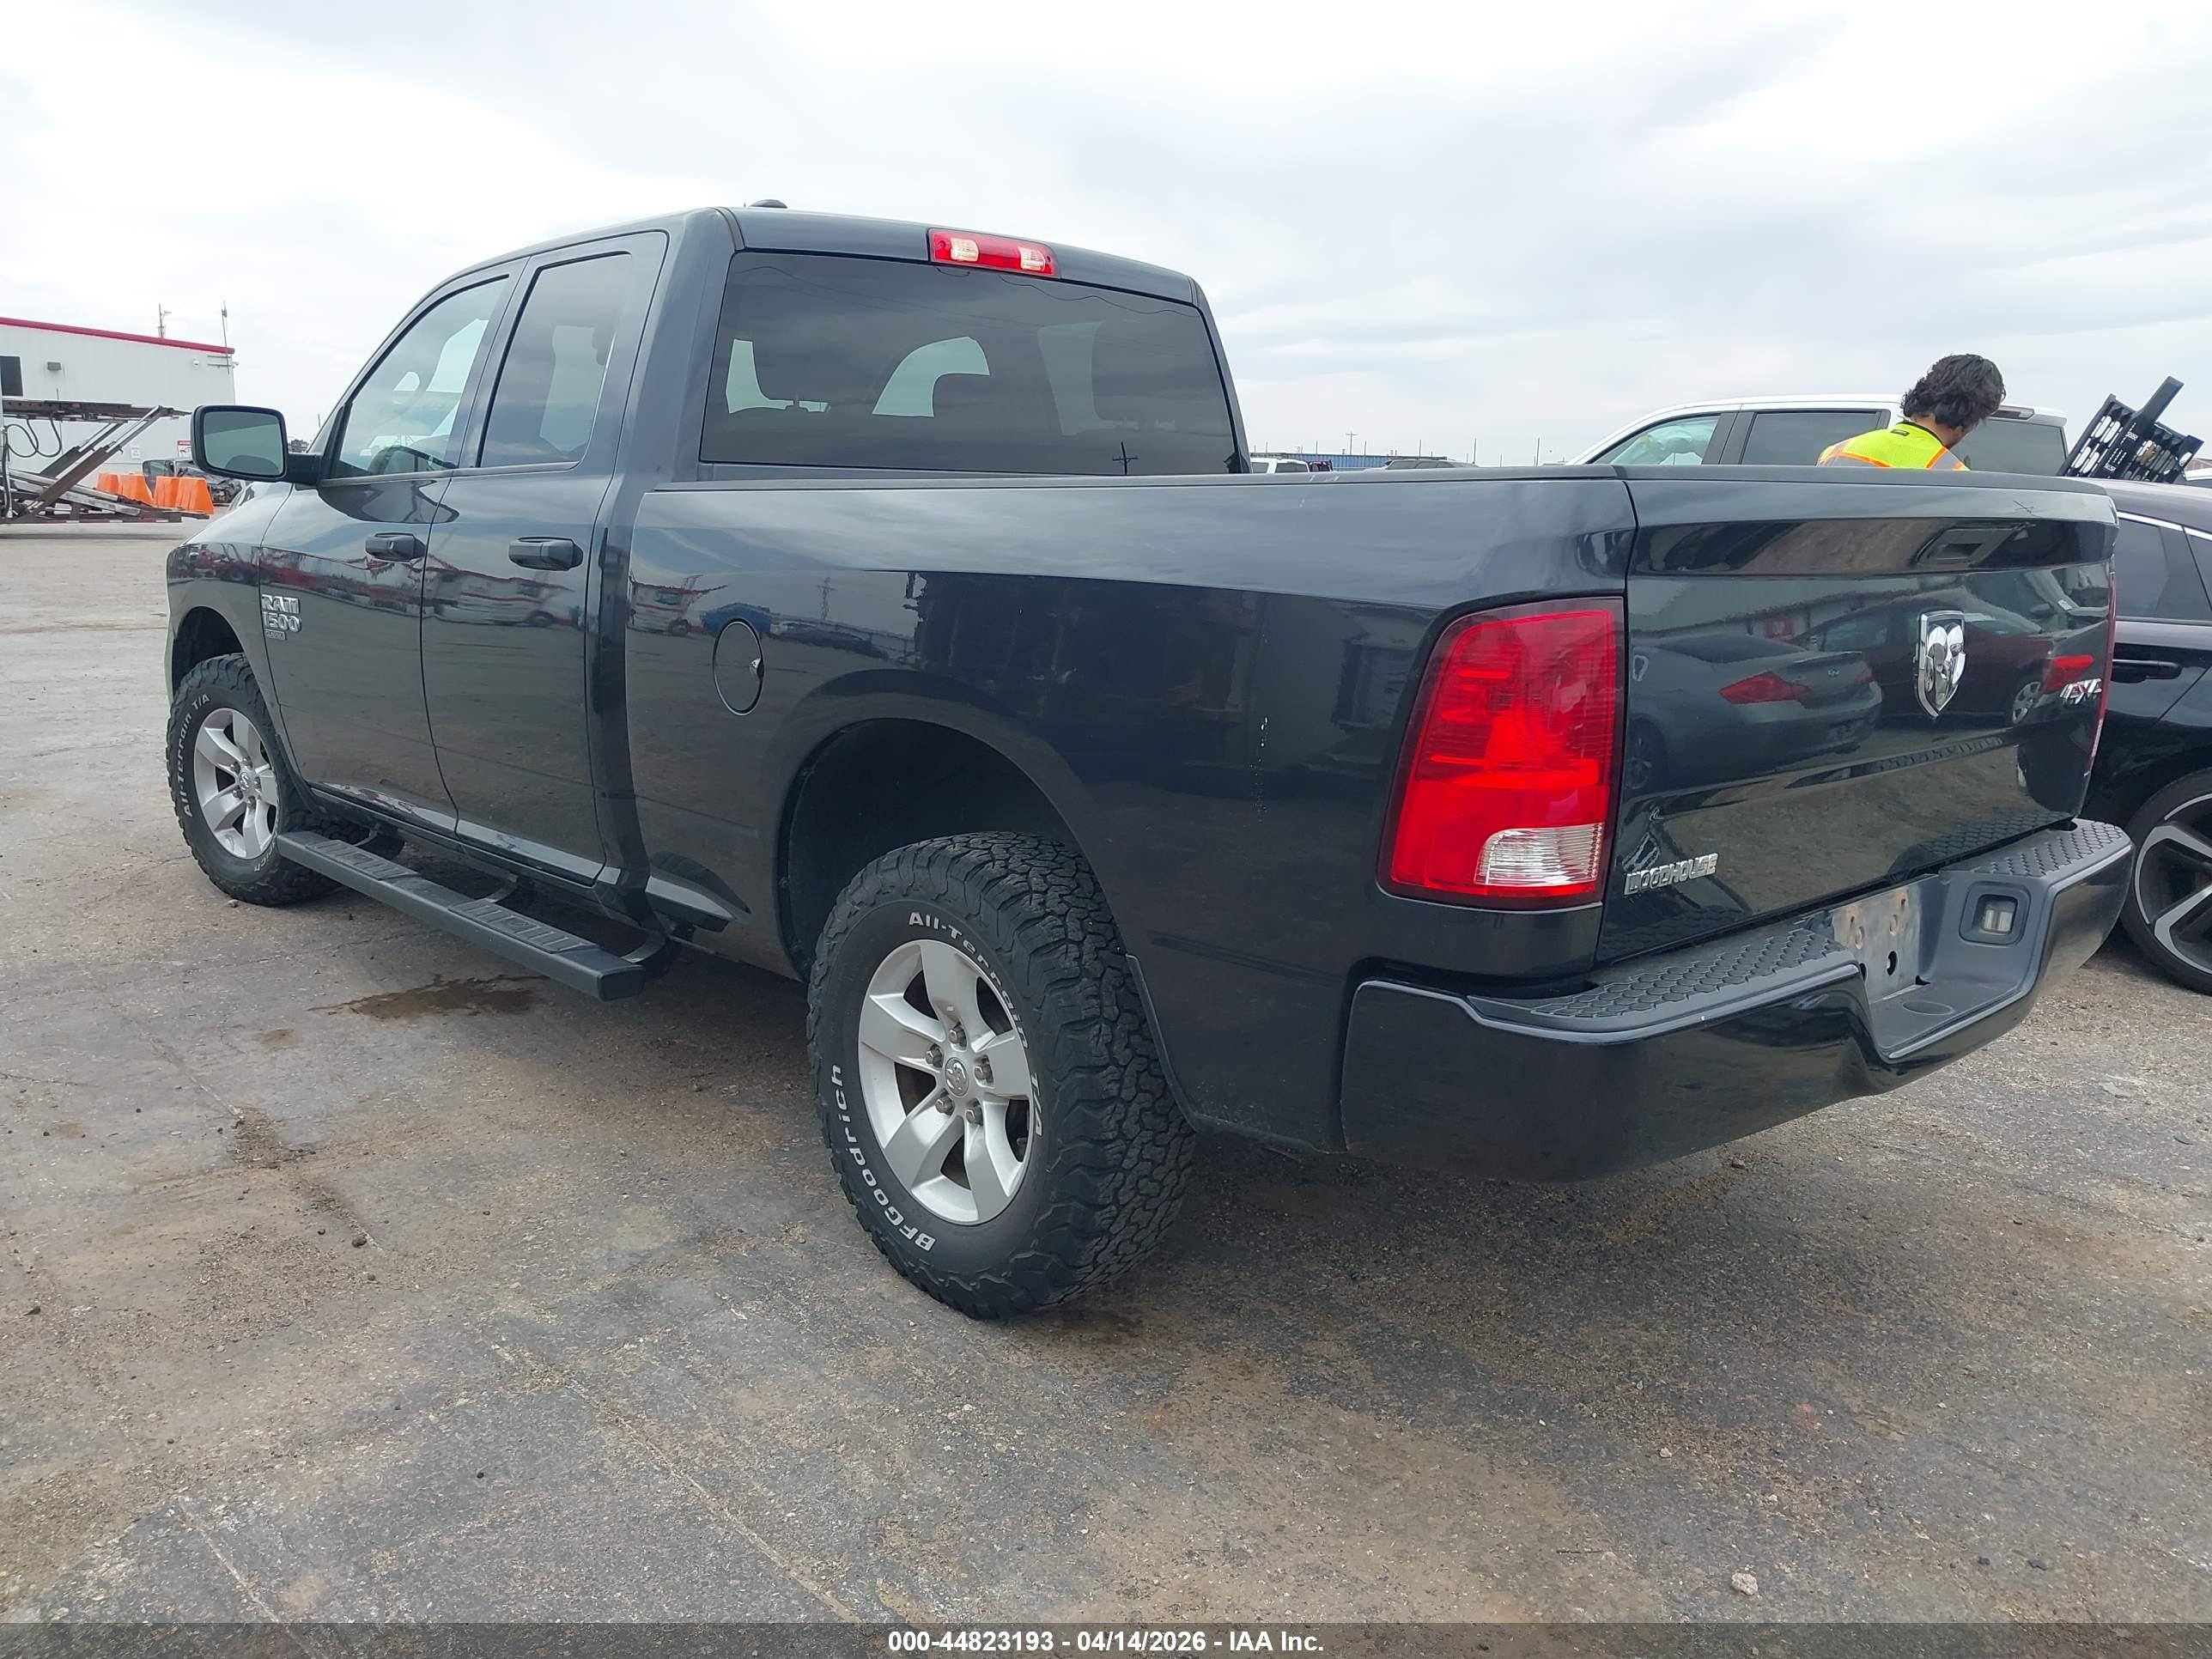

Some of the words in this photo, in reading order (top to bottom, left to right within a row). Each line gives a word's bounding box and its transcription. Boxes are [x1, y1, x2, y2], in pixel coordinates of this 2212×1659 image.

[261, 593, 301, 614] RAM
[262, 611, 302, 633] 1500
[177, 713, 193, 818] All-Terrain
[191, 693, 211, 711] T/A
[1624, 853, 1718, 896] WOODHOUSE
[908, 911, 1029, 1050] All-Terrain
[1030, 1072, 1043, 1137] T/A
[831, 1064, 937, 1252] BFGoodrich
